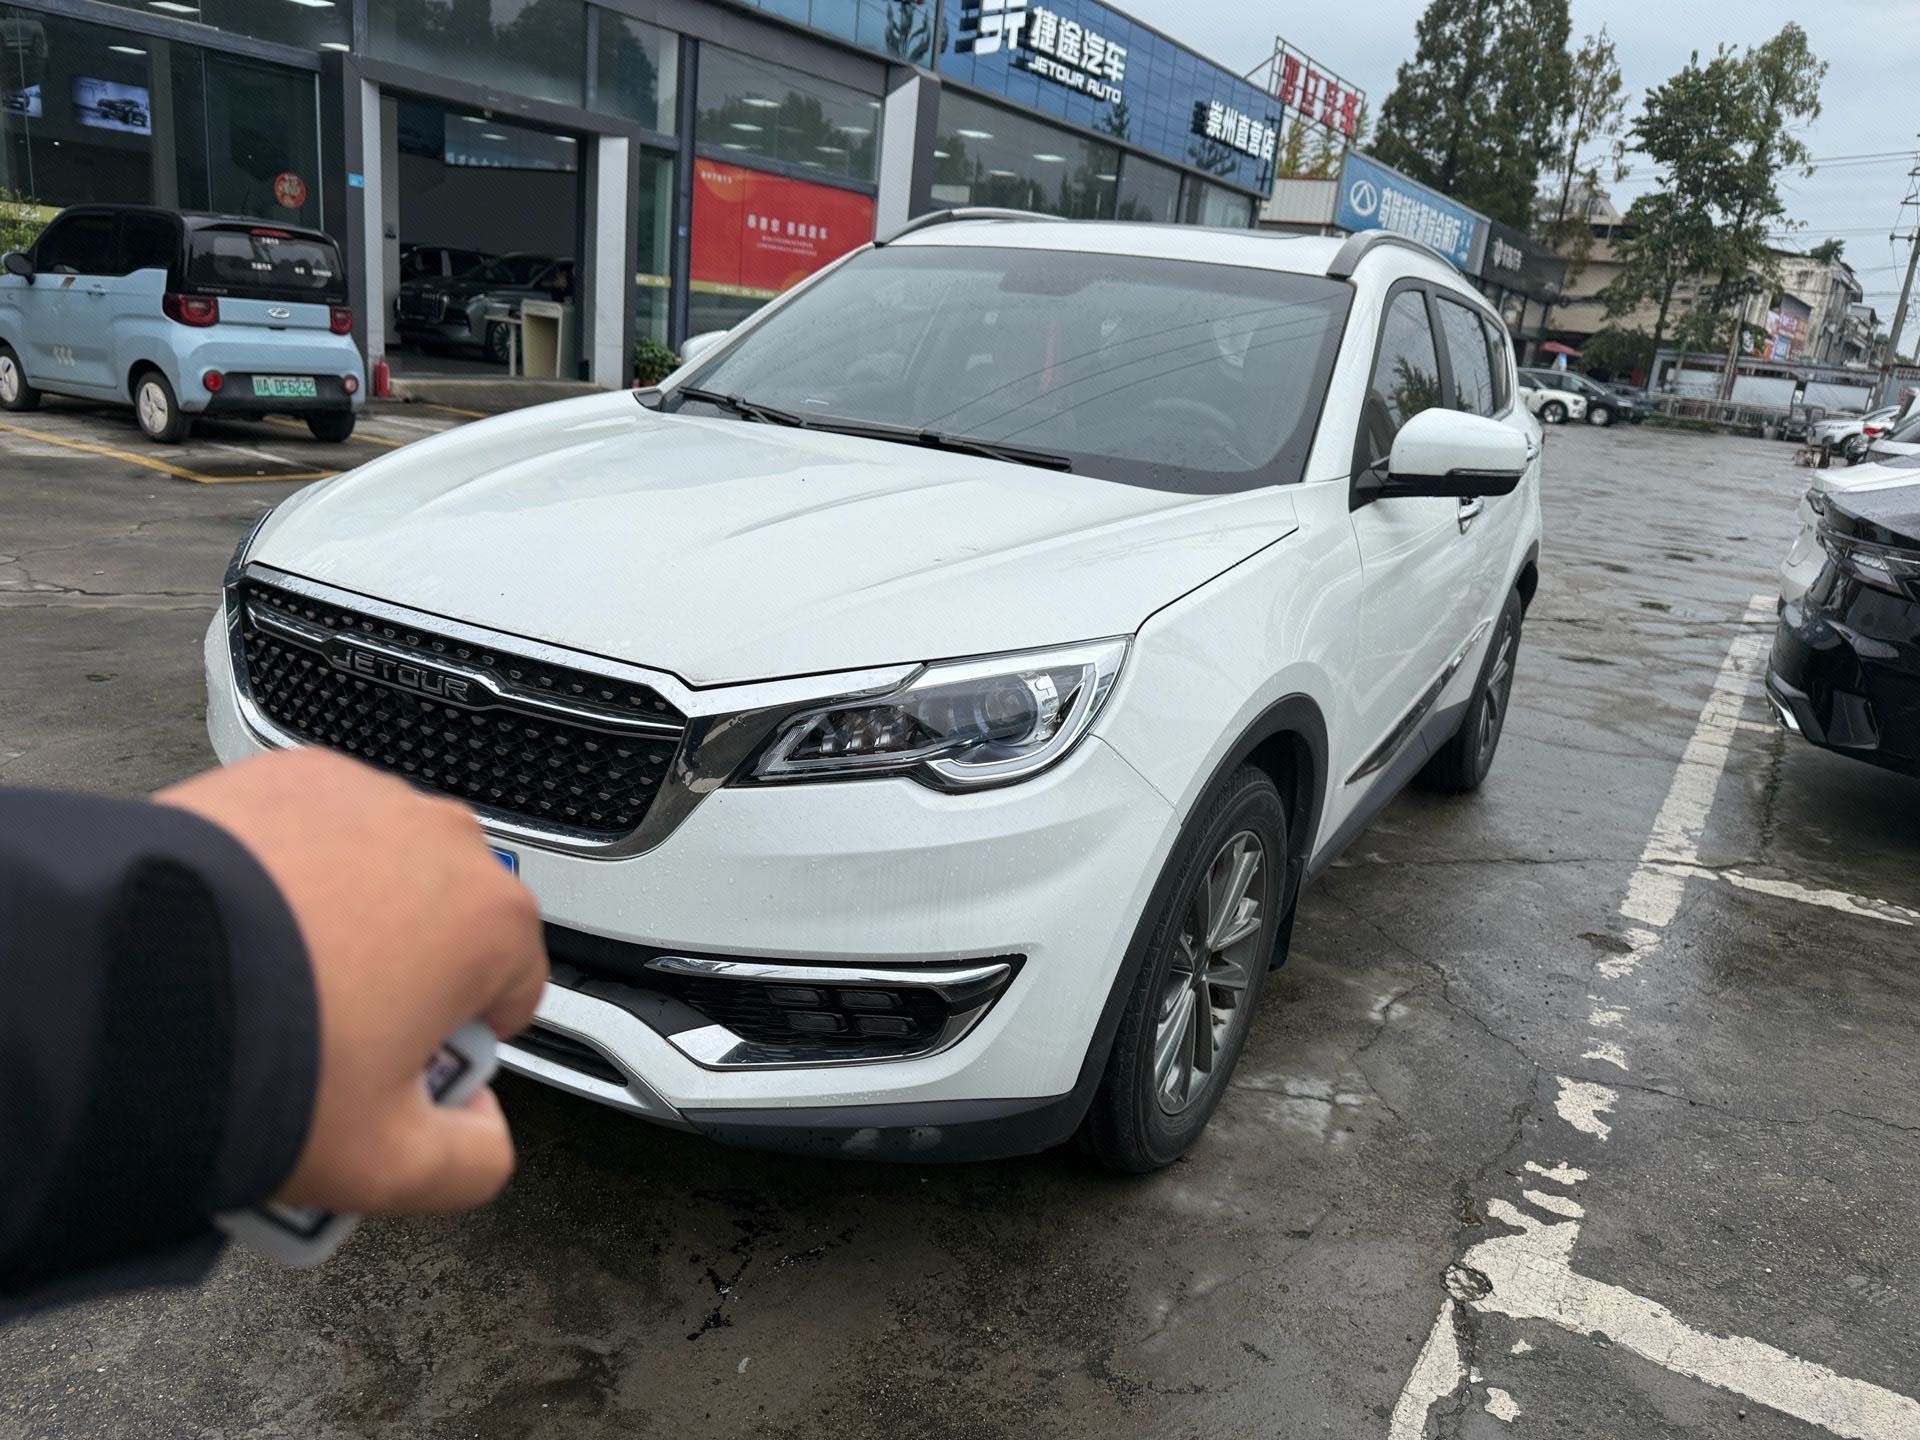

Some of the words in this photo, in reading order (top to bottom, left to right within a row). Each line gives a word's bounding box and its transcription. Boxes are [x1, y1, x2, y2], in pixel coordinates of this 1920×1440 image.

[1029, 6, 1128, 82] 捷途汽车
[1028, 55, 1085, 89] JETOUR
[1086, 78, 1122, 104] AUTO
[1206, 99, 1276, 160] 崇州直营店
[332, 649, 468, 702] JETOUR
